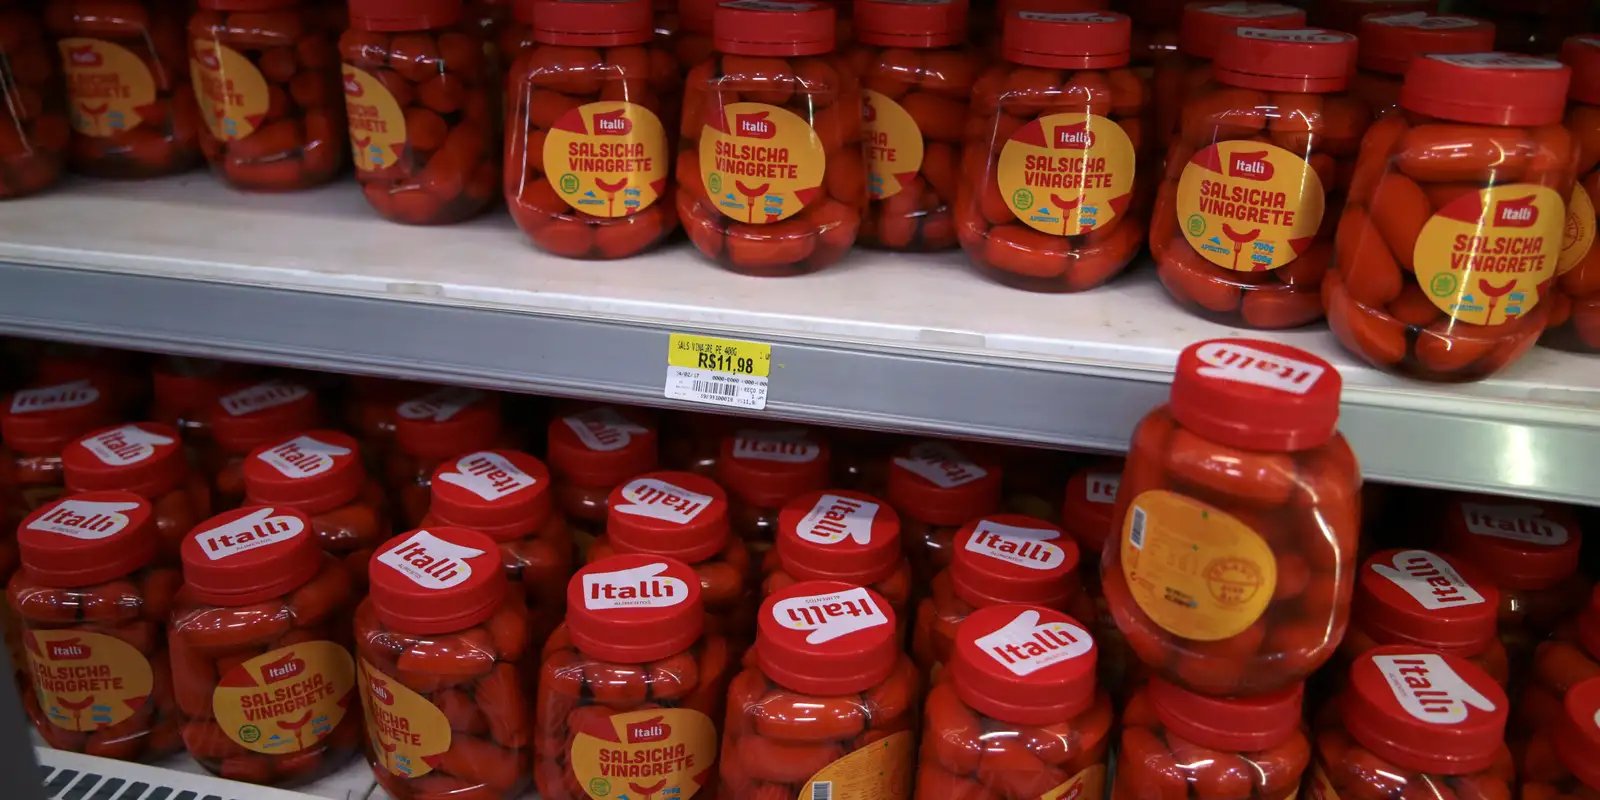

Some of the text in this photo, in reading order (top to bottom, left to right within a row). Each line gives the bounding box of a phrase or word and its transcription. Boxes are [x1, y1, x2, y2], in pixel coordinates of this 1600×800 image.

[600, 118, 625, 130] Italli
[742, 120, 768, 133] Italli
[568, 142, 644, 158] SALSICHA
[715, 140, 789, 163] SALSICHA
[568, 158, 652, 173] VINAGRETE
[715, 156, 798, 179] VINAGRETE
[1025, 155, 1105, 173] SALSICHA
[1236, 159, 1265, 174] Italli
[1024, 171, 1113, 189] VINAGRETE
[1200, 179, 1287, 209] SALSICHA
[1199, 196, 1295, 227] VINAGRETE
[1502, 207, 1532, 220] Italli
[1453, 234, 1543, 255] SALSICHA
[1451, 253, 1546, 273] VINAGRETE
[698, 352, 753, 375] R$11,98
[1213, 348, 1312, 383] Italli
[97, 431, 145, 460] Italli
[272, 442, 325, 473] Italli
[462, 457, 521, 492] Italli
[630, 484, 701, 515] Italli
[42, 508, 119, 533] Italli
[810, 499, 861, 538] Italli
[1472, 510, 1554, 537] Italli
[206, 520, 290, 551] Italli
[975, 530, 1054, 562] Italli
[394, 542, 463, 582] Italli
[591, 580, 674, 599] Italli
[1404, 557, 1467, 602] Italli
[787, 598, 873, 627] Italli
[993, 626, 1078, 663] Italli
[268, 662, 297, 678] Italli
[239, 673, 324, 709] SALSICHA
[1392, 660, 1461, 713] Italli
[243, 682, 335, 722] VINAGRETE
[634, 726, 662, 738] Italli
[599, 743, 686, 764] SALSICHA
[599, 754, 695, 778] VINAGRETE
